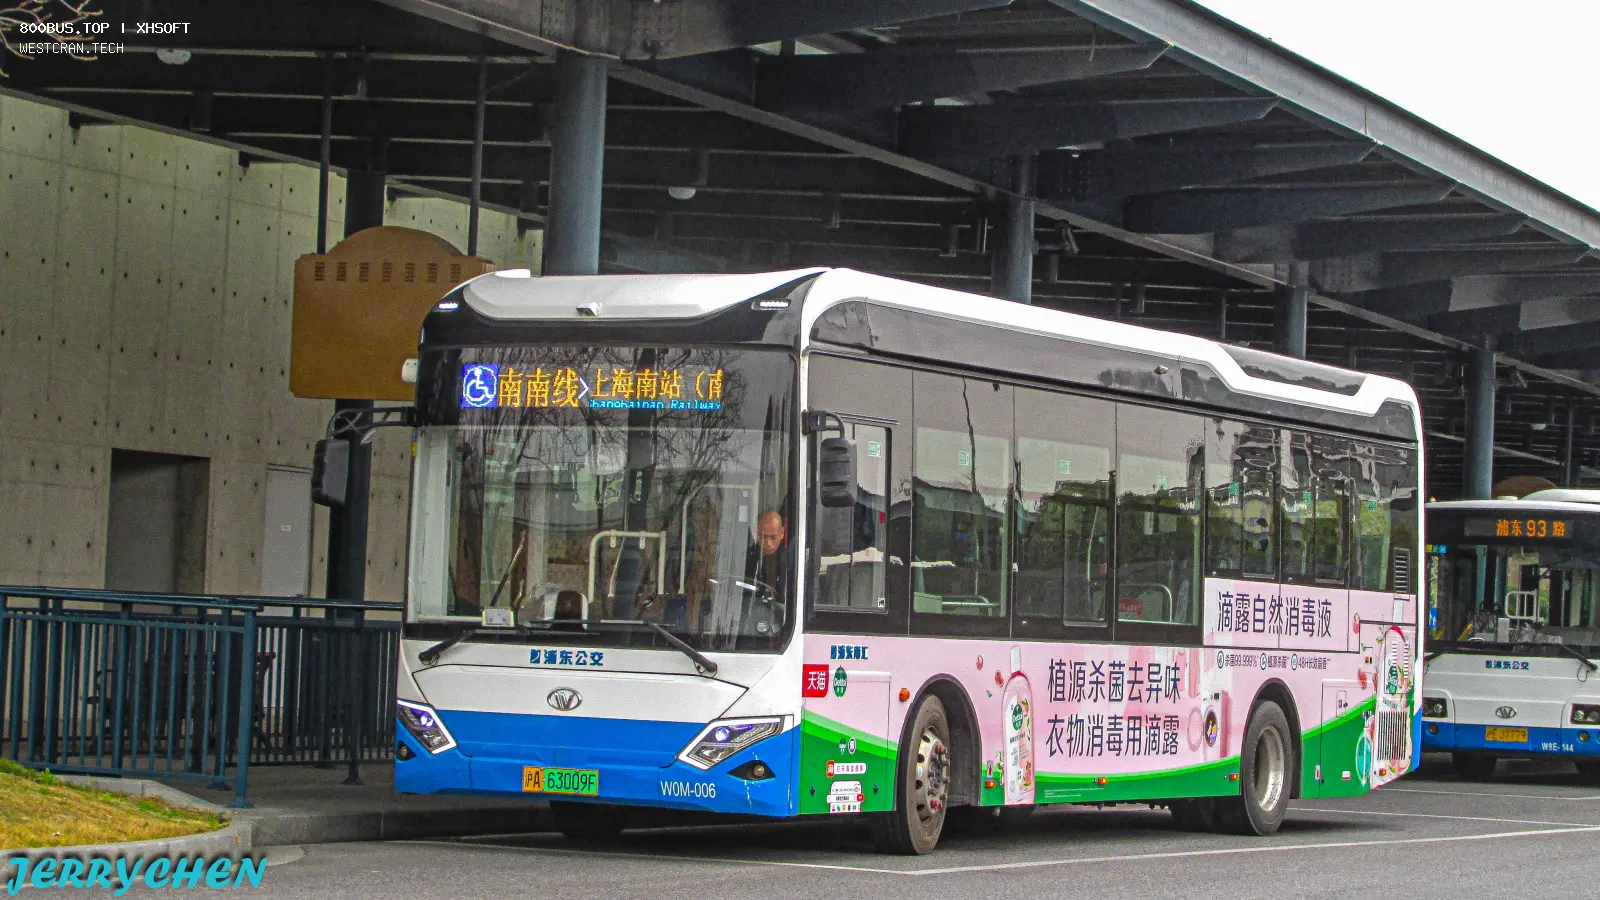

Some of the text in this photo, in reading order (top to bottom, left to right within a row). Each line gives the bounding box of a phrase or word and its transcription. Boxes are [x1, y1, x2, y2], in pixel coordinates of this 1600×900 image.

[498, 367, 579, 408] 南南线
[1496, 519, 1566, 538] 浦东 93 路
[1217, 590, 1332, 638] 滴露自然消毒液
[543, 649, 604, 666] 浦东公交
[807, 671, 827, 690] 天猫
[1047, 658, 1181, 704] 植源杀菌去异味
[1045, 713, 1180, 758] 衣物消毒用滴露
[546, 771, 597, 792] 63009F
